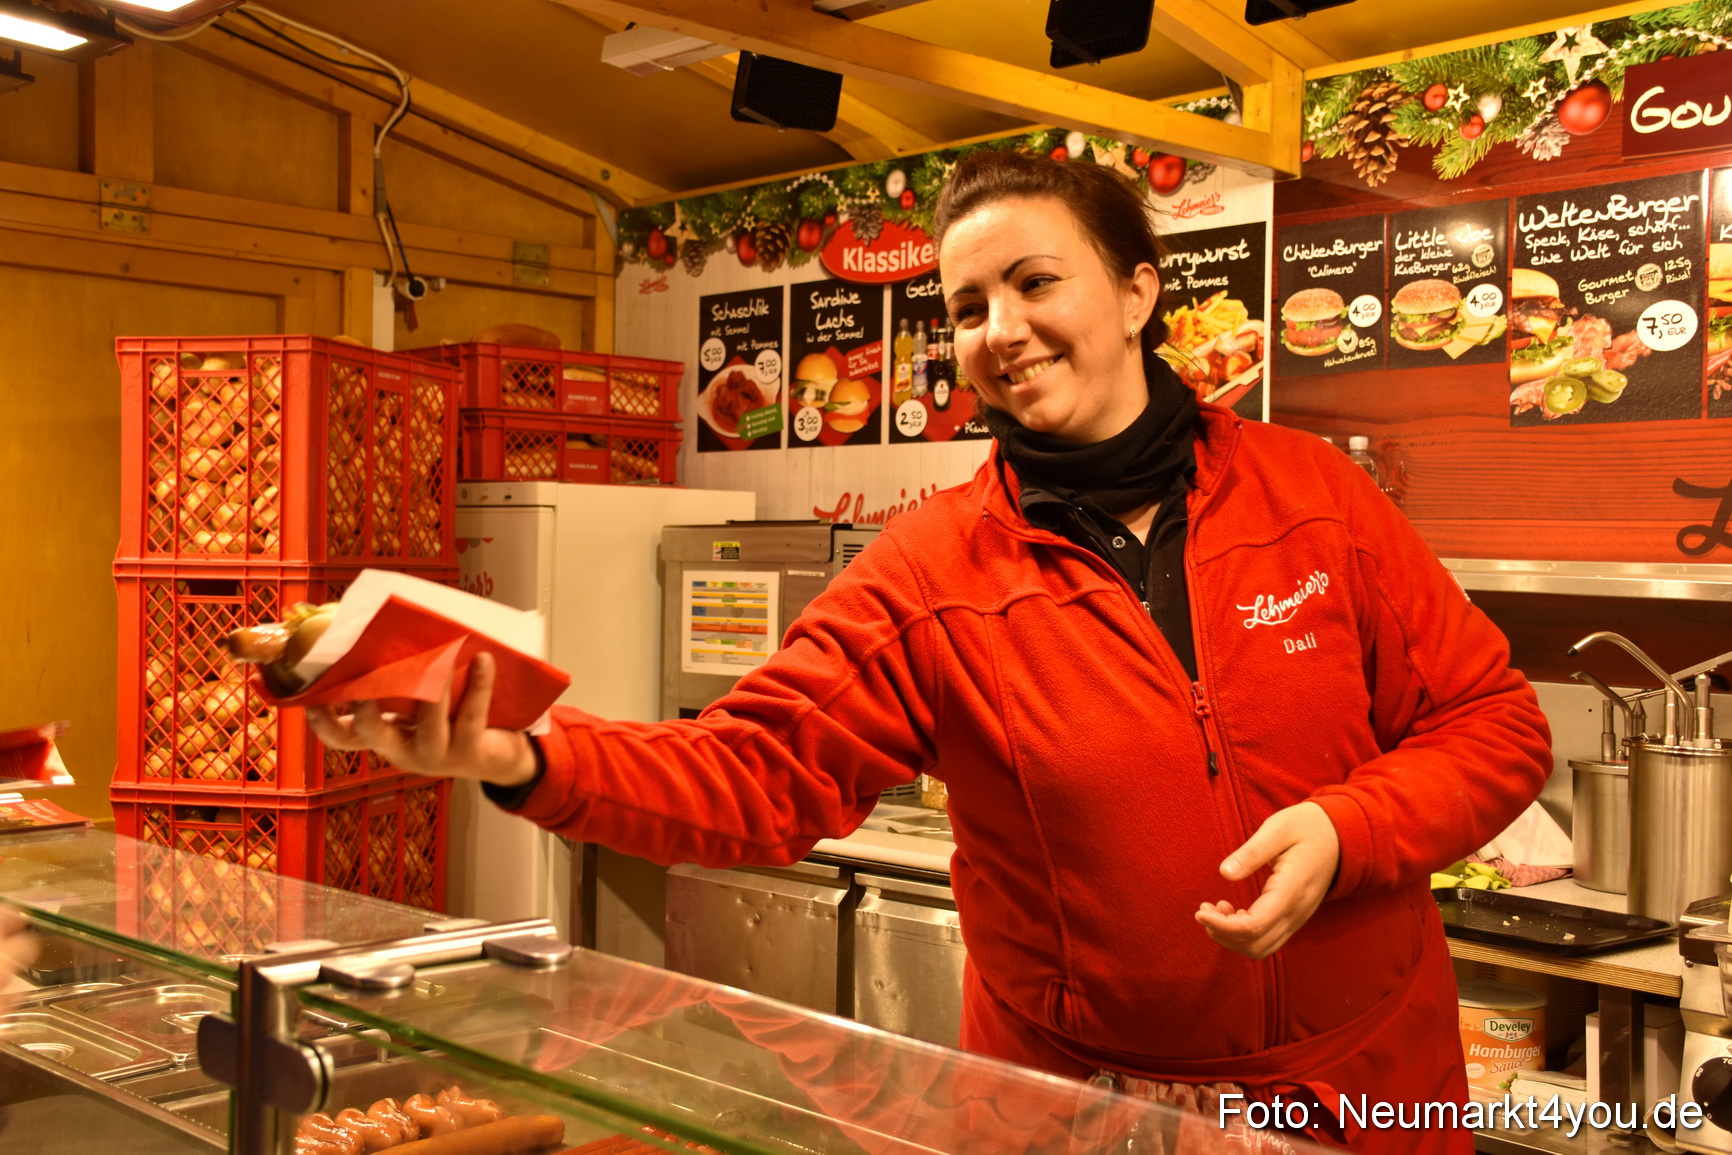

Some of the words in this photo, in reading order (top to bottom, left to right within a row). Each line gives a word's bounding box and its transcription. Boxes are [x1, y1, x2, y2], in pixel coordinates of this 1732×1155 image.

[1518, 193, 1699, 233] WeltenBurger
[1395, 226, 1448, 251] Little
[1457, 223, 1495, 244] Joe
[1524, 231, 1572, 251] Speck,
[1577, 226, 1620, 245] Käse,
[1158, 238, 1250, 276] urrywurst
[1283, 239, 1383, 262] ChickenBurger
[1394, 251, 1416, 263] der
[1421, 246, 1454, 260] kleine
[1530, 252, 1562, 266] eine
[1570, 246, 1611, 264] Welt
[1618, 239, 1645, 257] für
[1652, 232, 1684, 253] sich
[1452, 262, 1470, 274] 62g
[1664, 256, 1692, 272] 125g
[1163, 278, 1182, 292] mit
[1186, 275, 1229, 290] Pommes
[1577, 269, 1635, 293] Gourmet
[1665, 269, 1692, 285] Rind!
[810, 288, 861, 310] Sardine
[906, 279, 943, 299] Getr
[1584, 287, 1630, 307] Burger
[711, 298, 770, 322] Schaschlik
[815, 308, 855, 331] Lachs
[725, 322, 750, 336] Semmel
[806, 332, 814, 343] in
[817, 330, 833, 343] der
[835, 326, 865, 341] Semmel
[1642, 313, 1684, 339] 7,50
[1667, 326, 1687, 336] EUR
[751, 338, 779, 350] Pommes
[1236, 570, 1329, 629] Lehmeier's
[1283, 632, 1317, 654] Dali
[1490, 1020, 1532, 1034] Develey
[1469, 1043, 1541, 1062] Hamburger
[1490, 1059, 1525, 1074] Sauce
